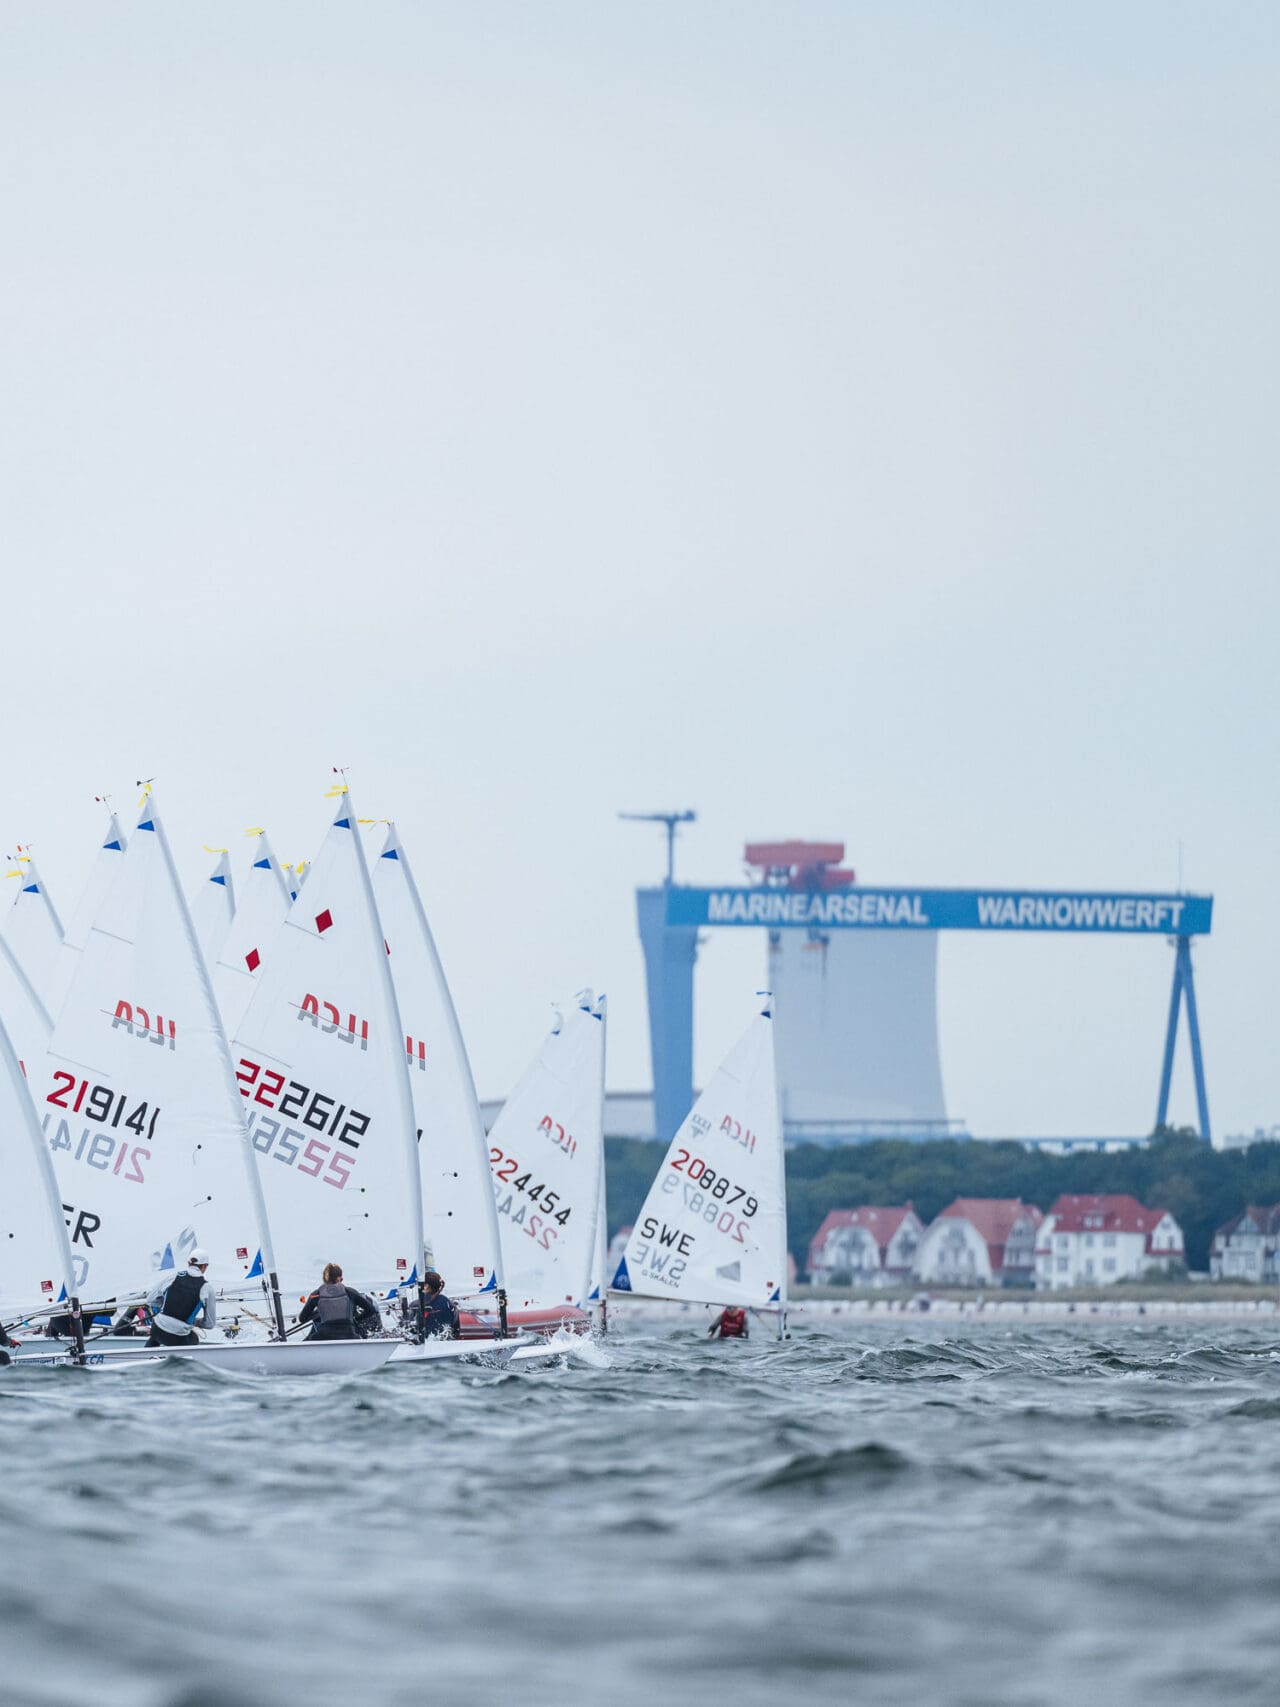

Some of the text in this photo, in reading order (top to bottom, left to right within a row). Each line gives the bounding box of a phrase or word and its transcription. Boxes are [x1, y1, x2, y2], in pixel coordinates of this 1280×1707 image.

[708, 892, 1186, 929] MARINEARSENAL WARNOWWERFT
[46, 1070, 160, 1140] 219141
[235, 1059, 371, 1149] 222612
[489, 1148, 572, 1226] 224454
[671, 1148, 759, 1217] 208879
[640, 1217, 695, 1256] SWE
